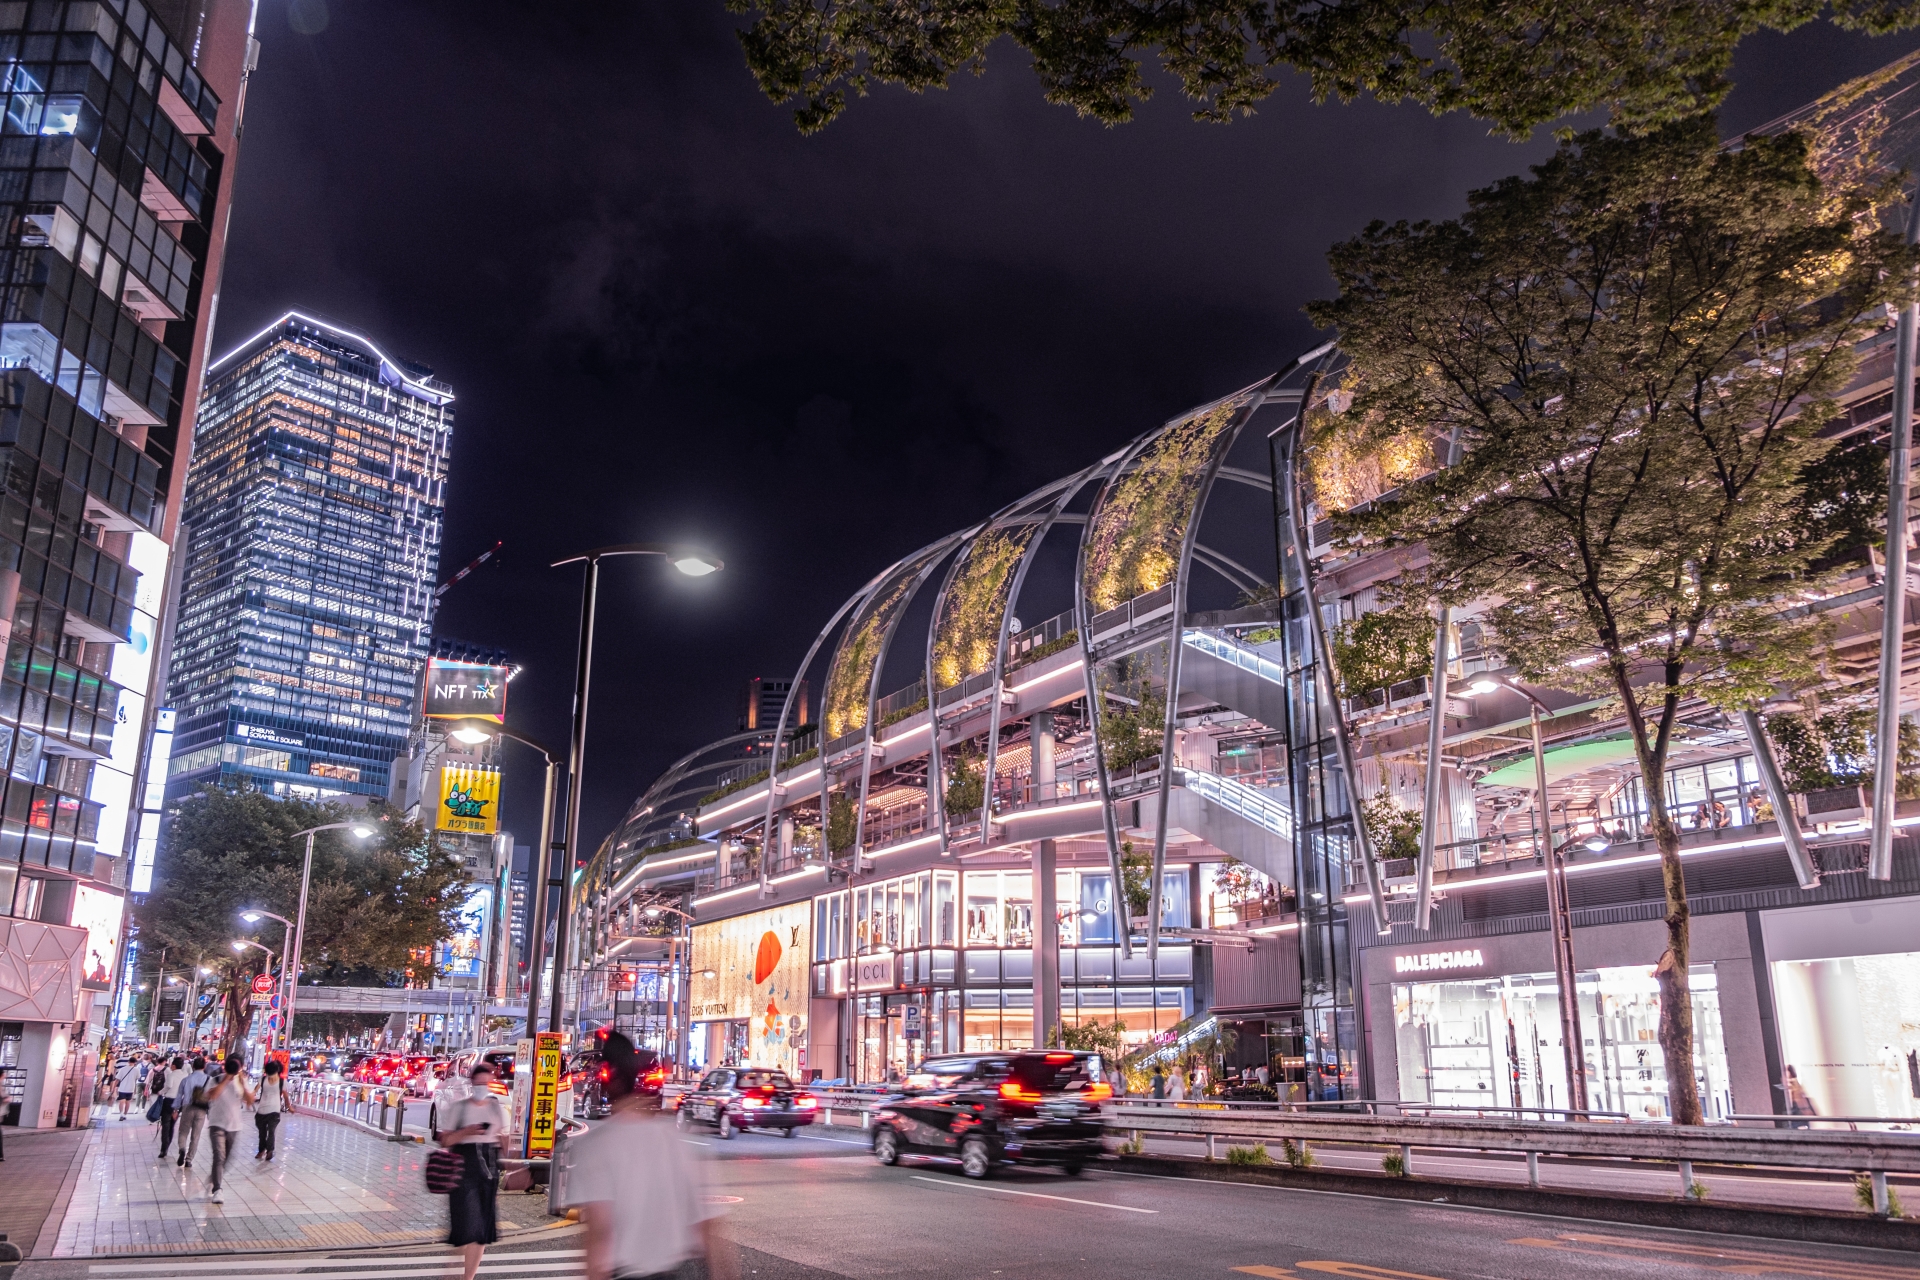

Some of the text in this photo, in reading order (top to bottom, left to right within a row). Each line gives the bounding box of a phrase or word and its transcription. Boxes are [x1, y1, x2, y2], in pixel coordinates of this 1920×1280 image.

[434, 684, 490, 699] NFT TTX
[250, 726, 275, 736] SHIBUYA
[249, 731, 303, 747] SCRAMBLE SQUARE
[1395, 949, 1484, 973] BALENCIAGA
[691, 1004, 703, 1016] OUIS
[907, 1007, 918, 1020] P
[540, 1054, 557, 1068] 100
[534, 1082, 554, 1135] 工事中
